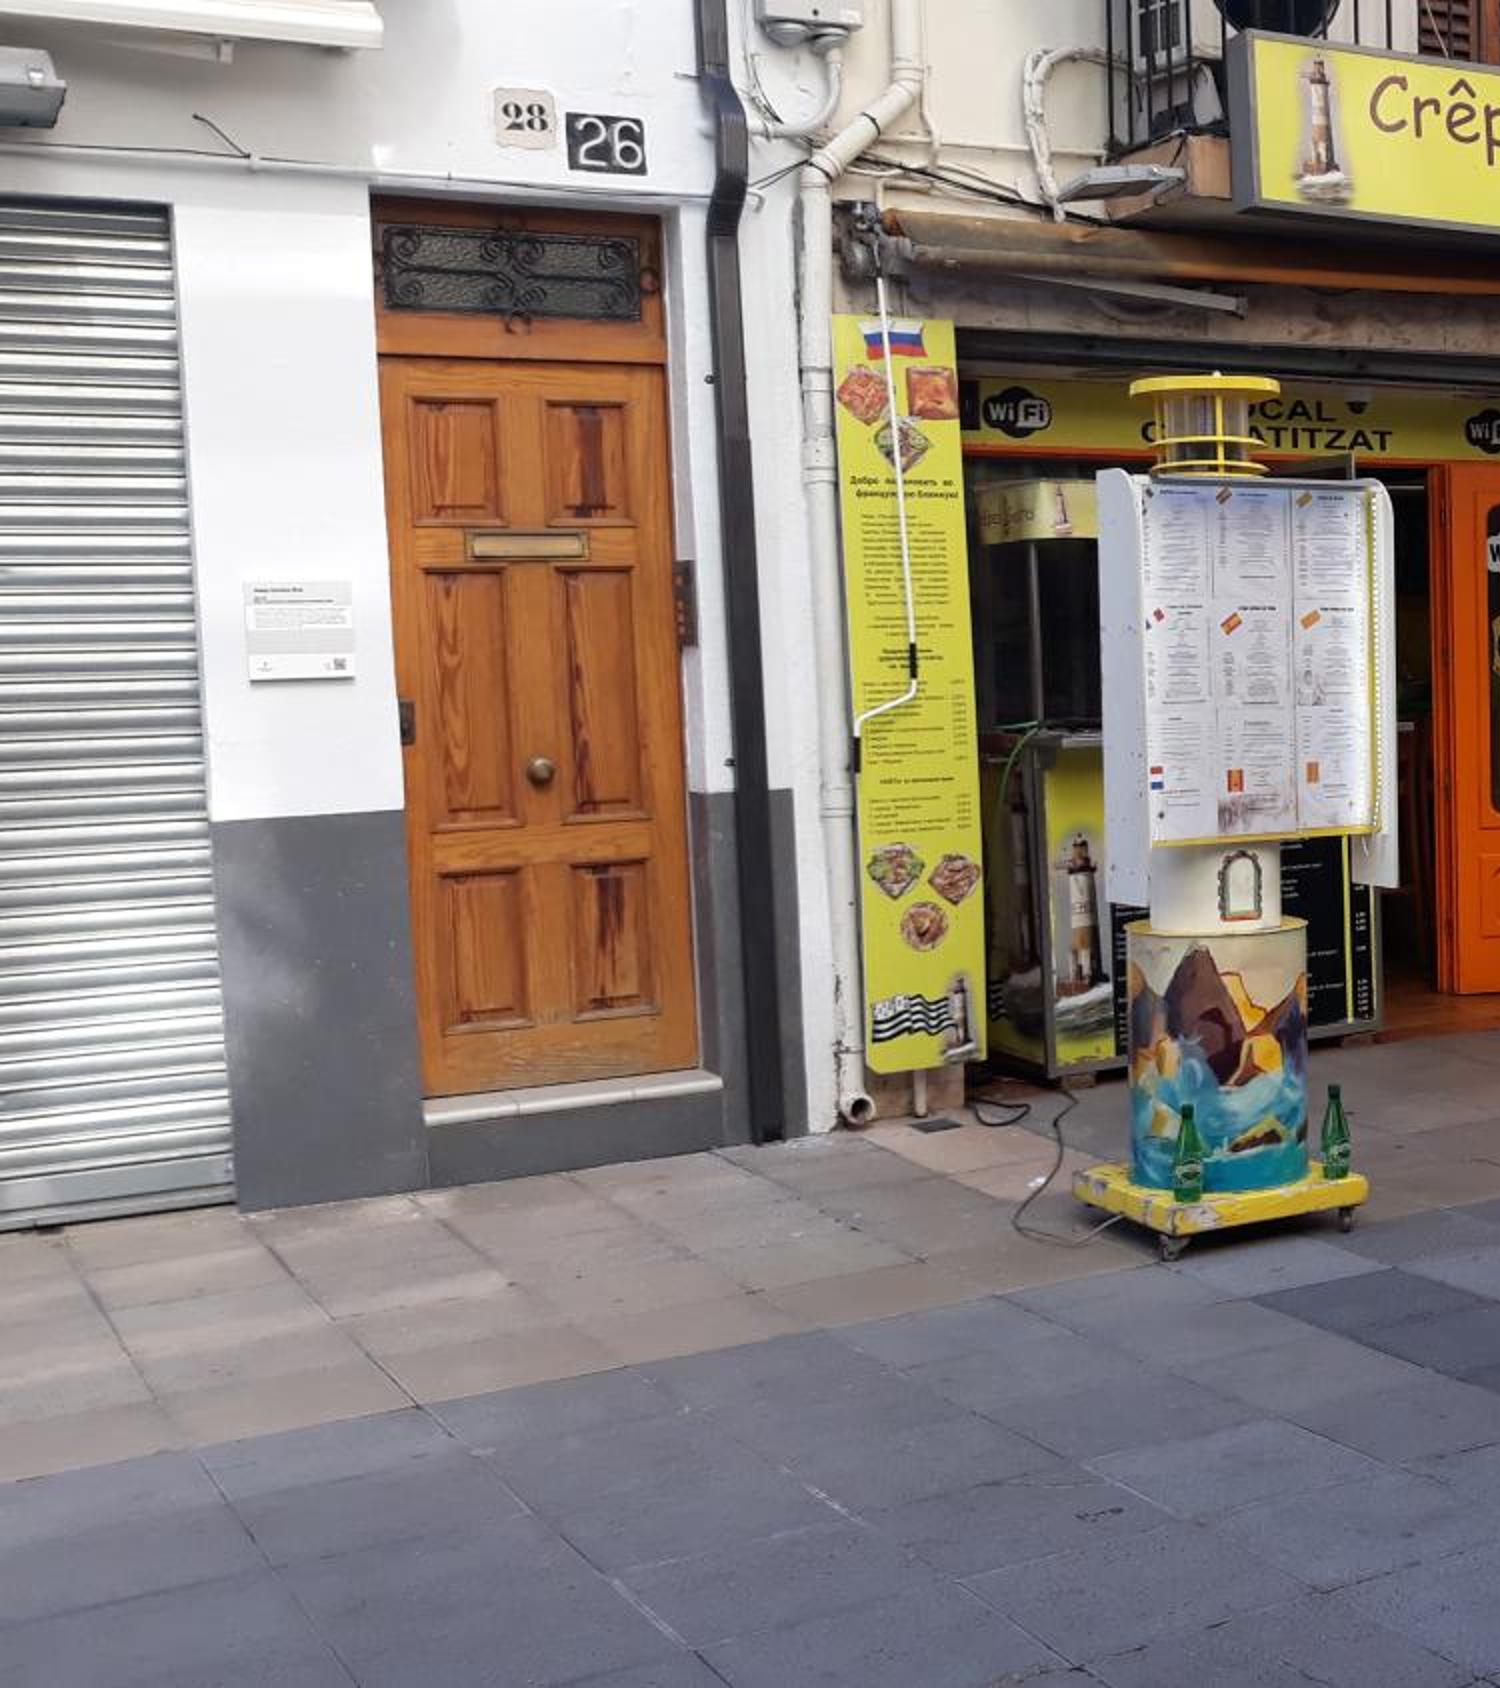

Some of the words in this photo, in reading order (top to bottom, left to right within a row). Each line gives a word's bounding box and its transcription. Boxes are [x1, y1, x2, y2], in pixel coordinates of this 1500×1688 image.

[502, 101, 549, 132] 28
[574, 116, 643, 169] 26
[1247, 398, 1337, 423] CAL
